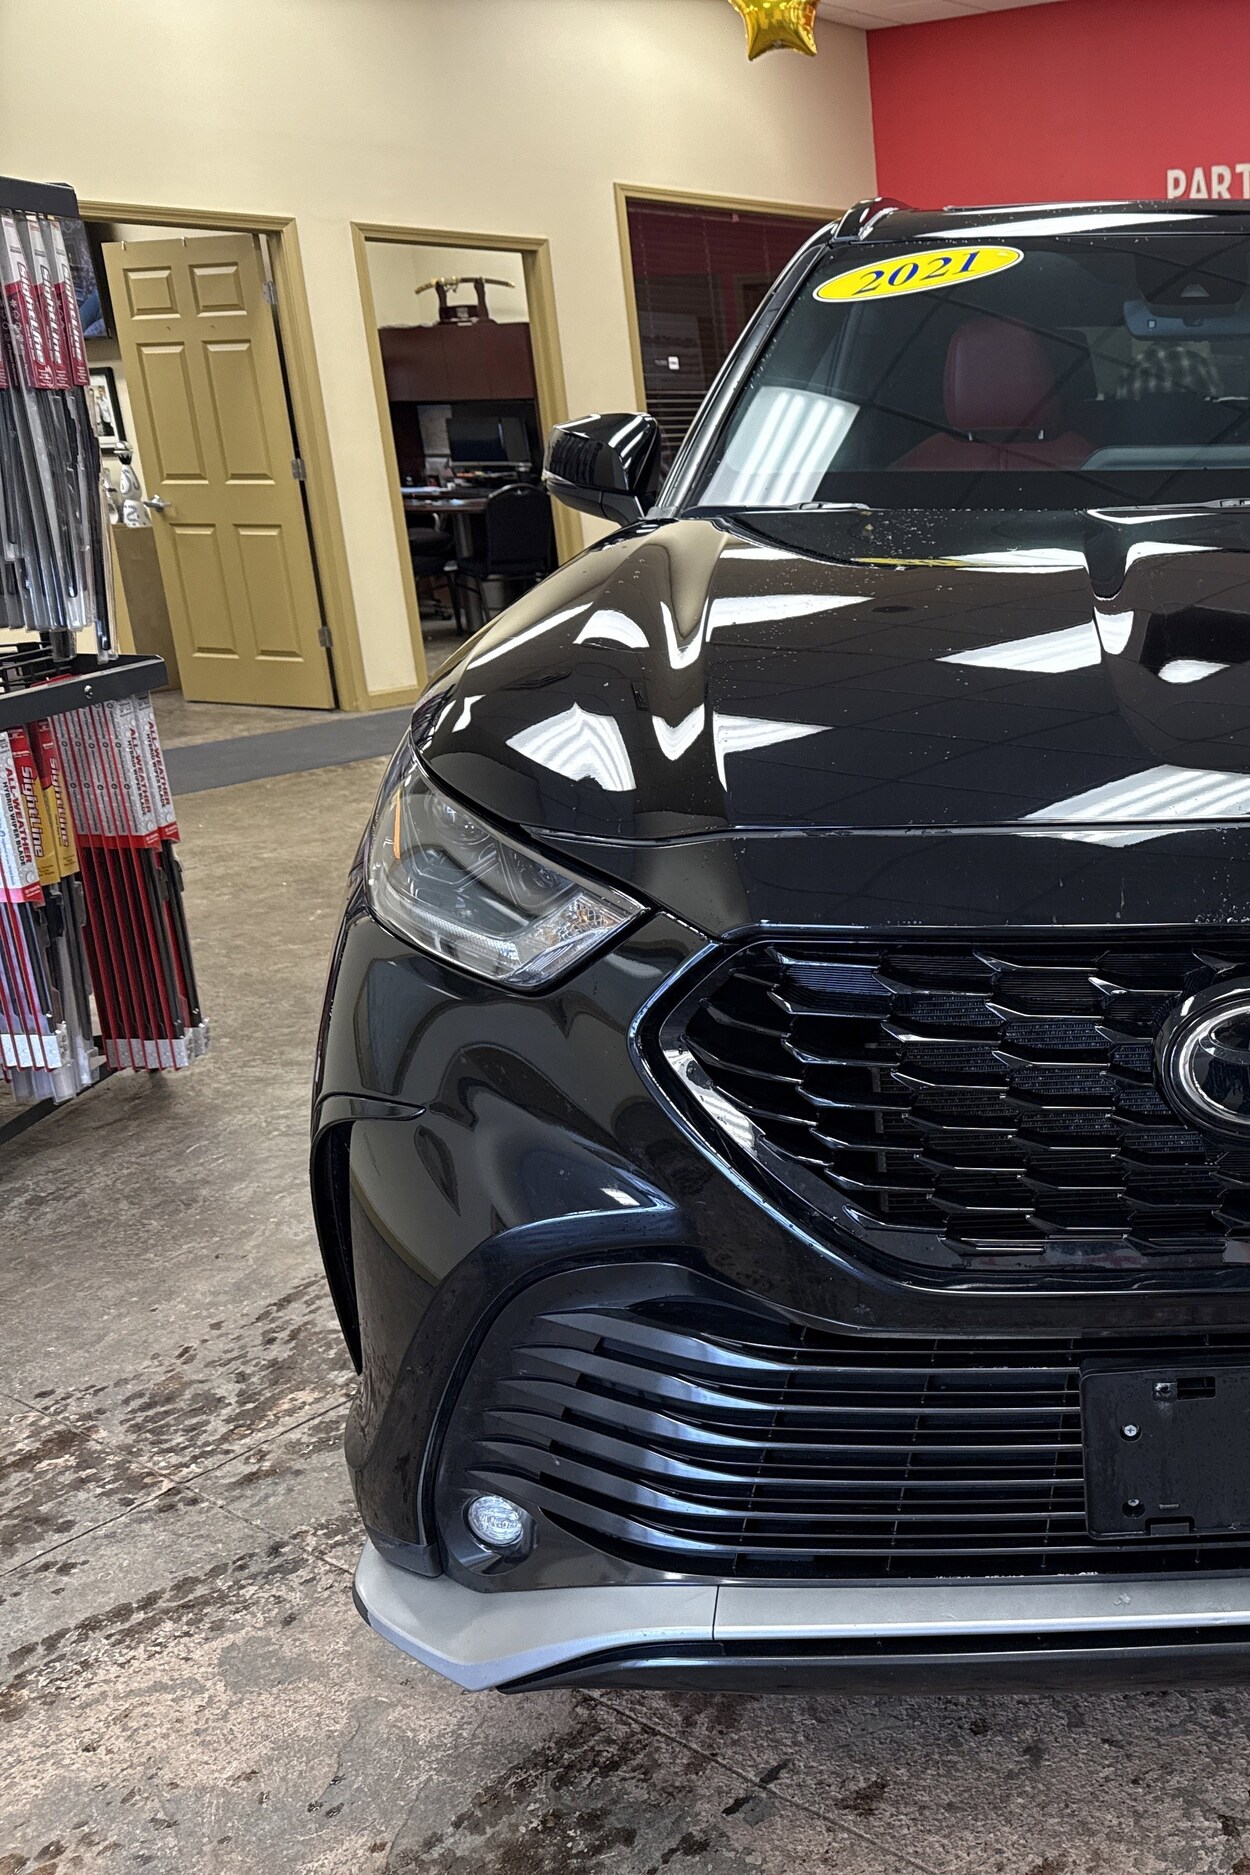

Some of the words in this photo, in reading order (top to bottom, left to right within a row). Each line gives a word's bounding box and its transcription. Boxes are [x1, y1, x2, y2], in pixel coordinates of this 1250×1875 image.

[851, 251, 981, 296] 2021
[129, 727, 152, 813] ALL-WEATHER
[148, 721, 171, 805] ALL-WEATHER
[2, 781, 14, 812] HYBRID
[9, 813, 20, 839] WIPER
[15, 840, 26, 867] BLADE
[5, 766, 32, 864] ALL-WEATHER
[21, 764, 44, 858] SightLine
